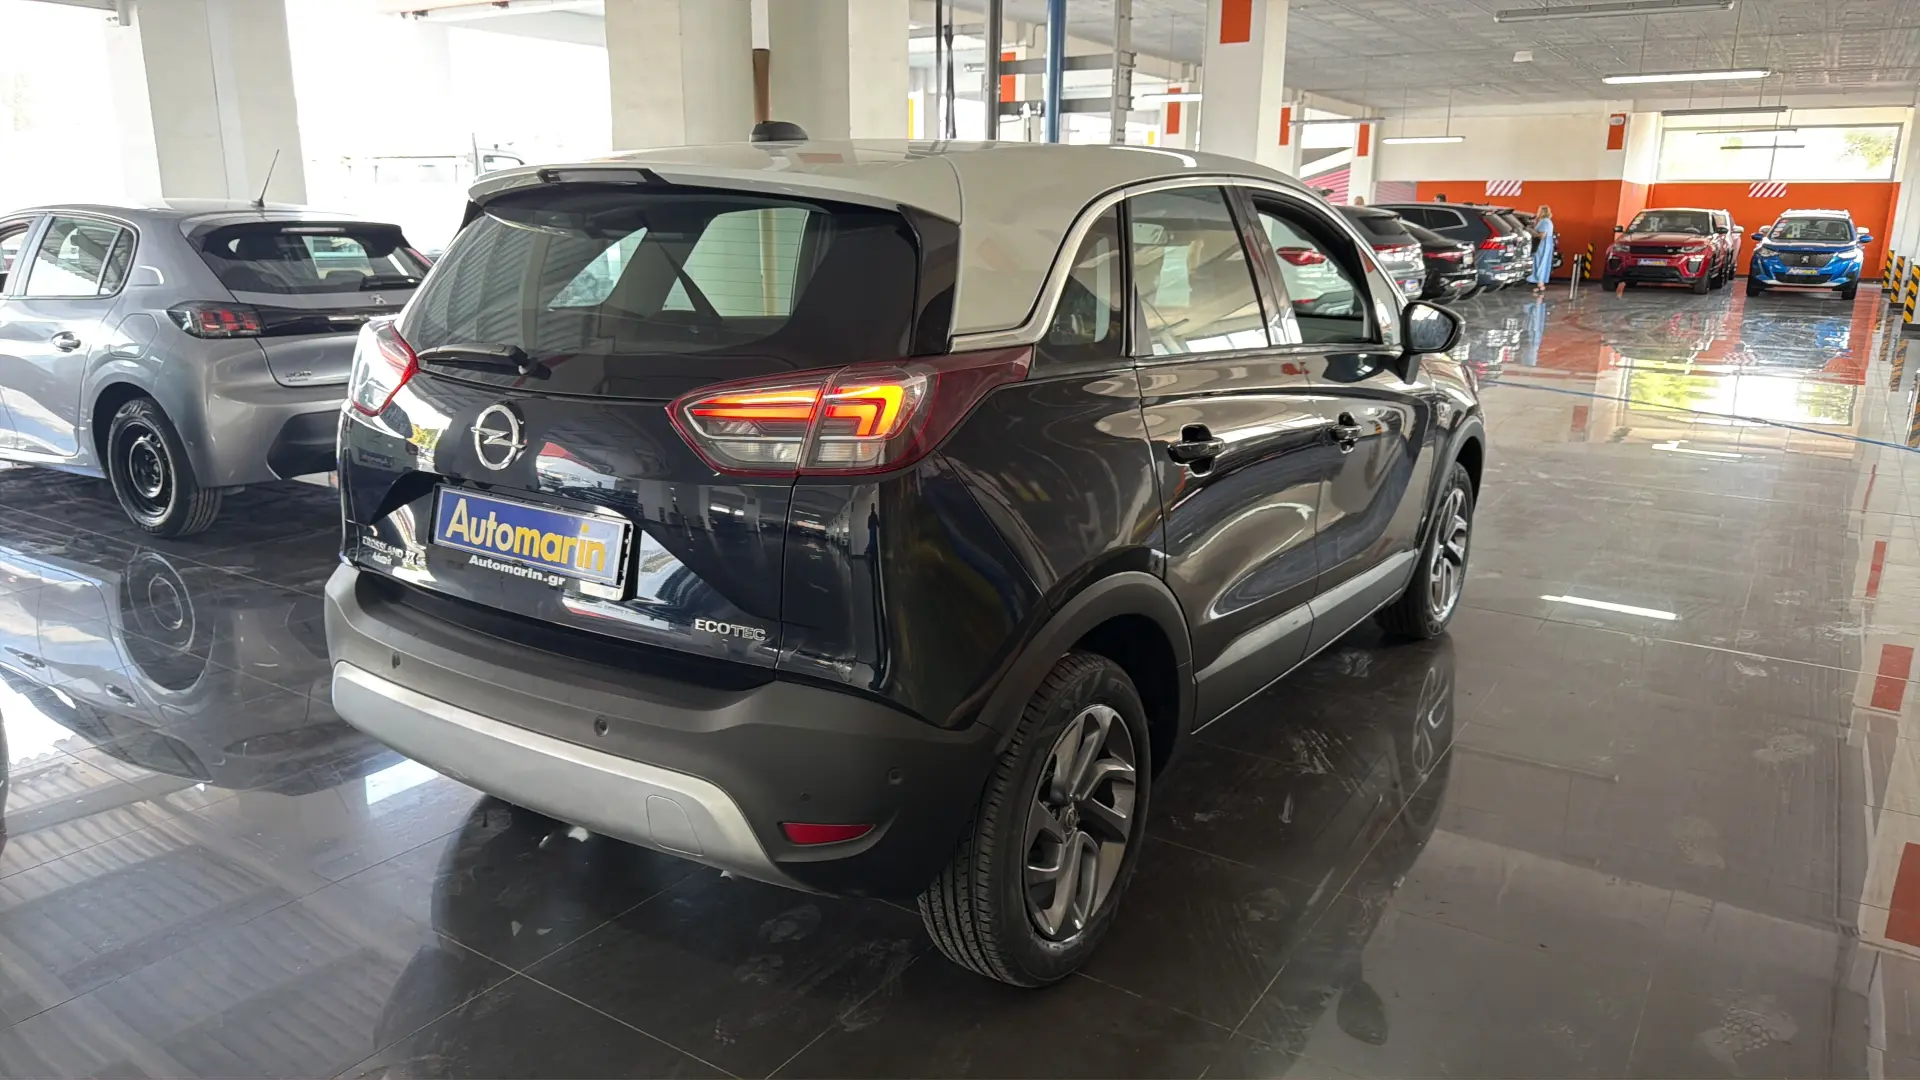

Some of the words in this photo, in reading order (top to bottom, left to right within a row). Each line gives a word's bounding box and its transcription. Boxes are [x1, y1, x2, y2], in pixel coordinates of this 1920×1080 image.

[445, 498, 606, 572] Automarin
[468, 555, 566, 586] Automarin.gr
[694, 618, 766, 641] ECOTEC
